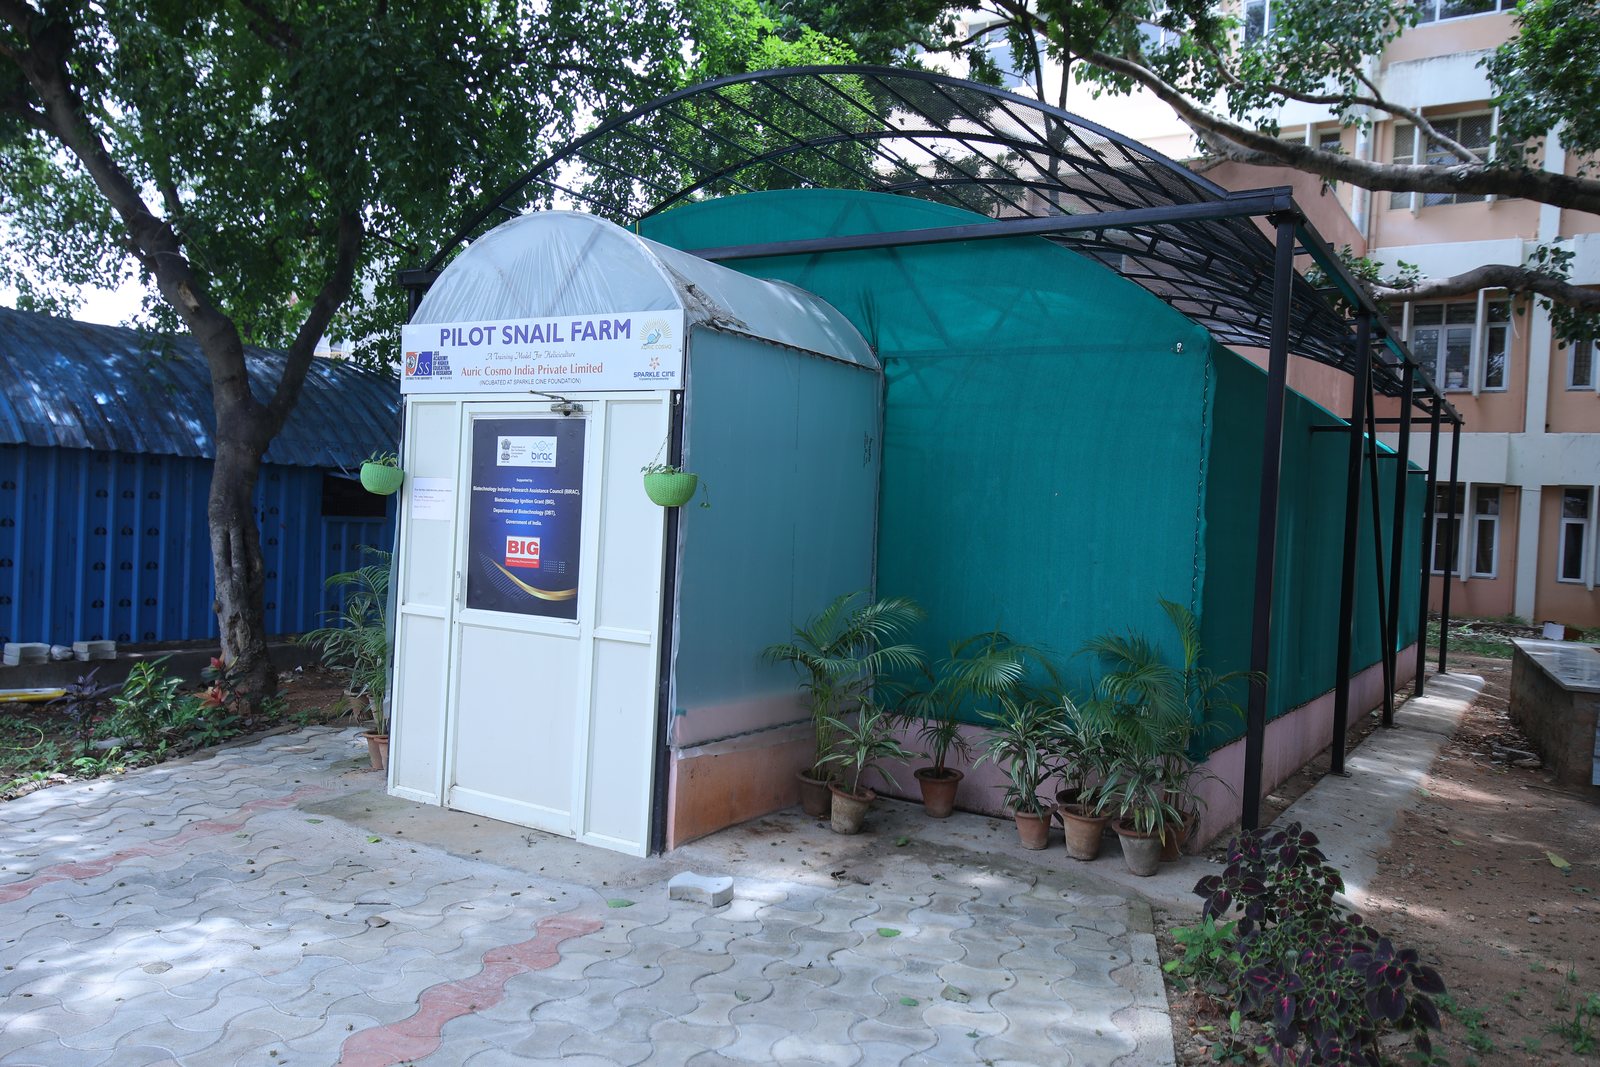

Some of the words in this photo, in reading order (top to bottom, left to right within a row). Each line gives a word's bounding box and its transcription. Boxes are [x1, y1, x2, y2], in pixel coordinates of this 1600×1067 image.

[440, 326, 497, 347] PILOT
[502, 322, 564, 345] SNAIL
[570, 318, 631, 341] FARM
[485, 352, 493, 360] A
[494, 352, 513, 362] Training
[514, 351, 532, 360] Model
[532, 351, 542, 360] For
[461, 366, 481, 376] Auric
[484, 366, 512, 376] Cosmo
[514, 364, 535, 375] India
[537, 364, 568, 374] Private
[570, 362, 603, 374] Limited
[531, 451, 552, 461] birac
[507, 540, 539, 556] BIG
